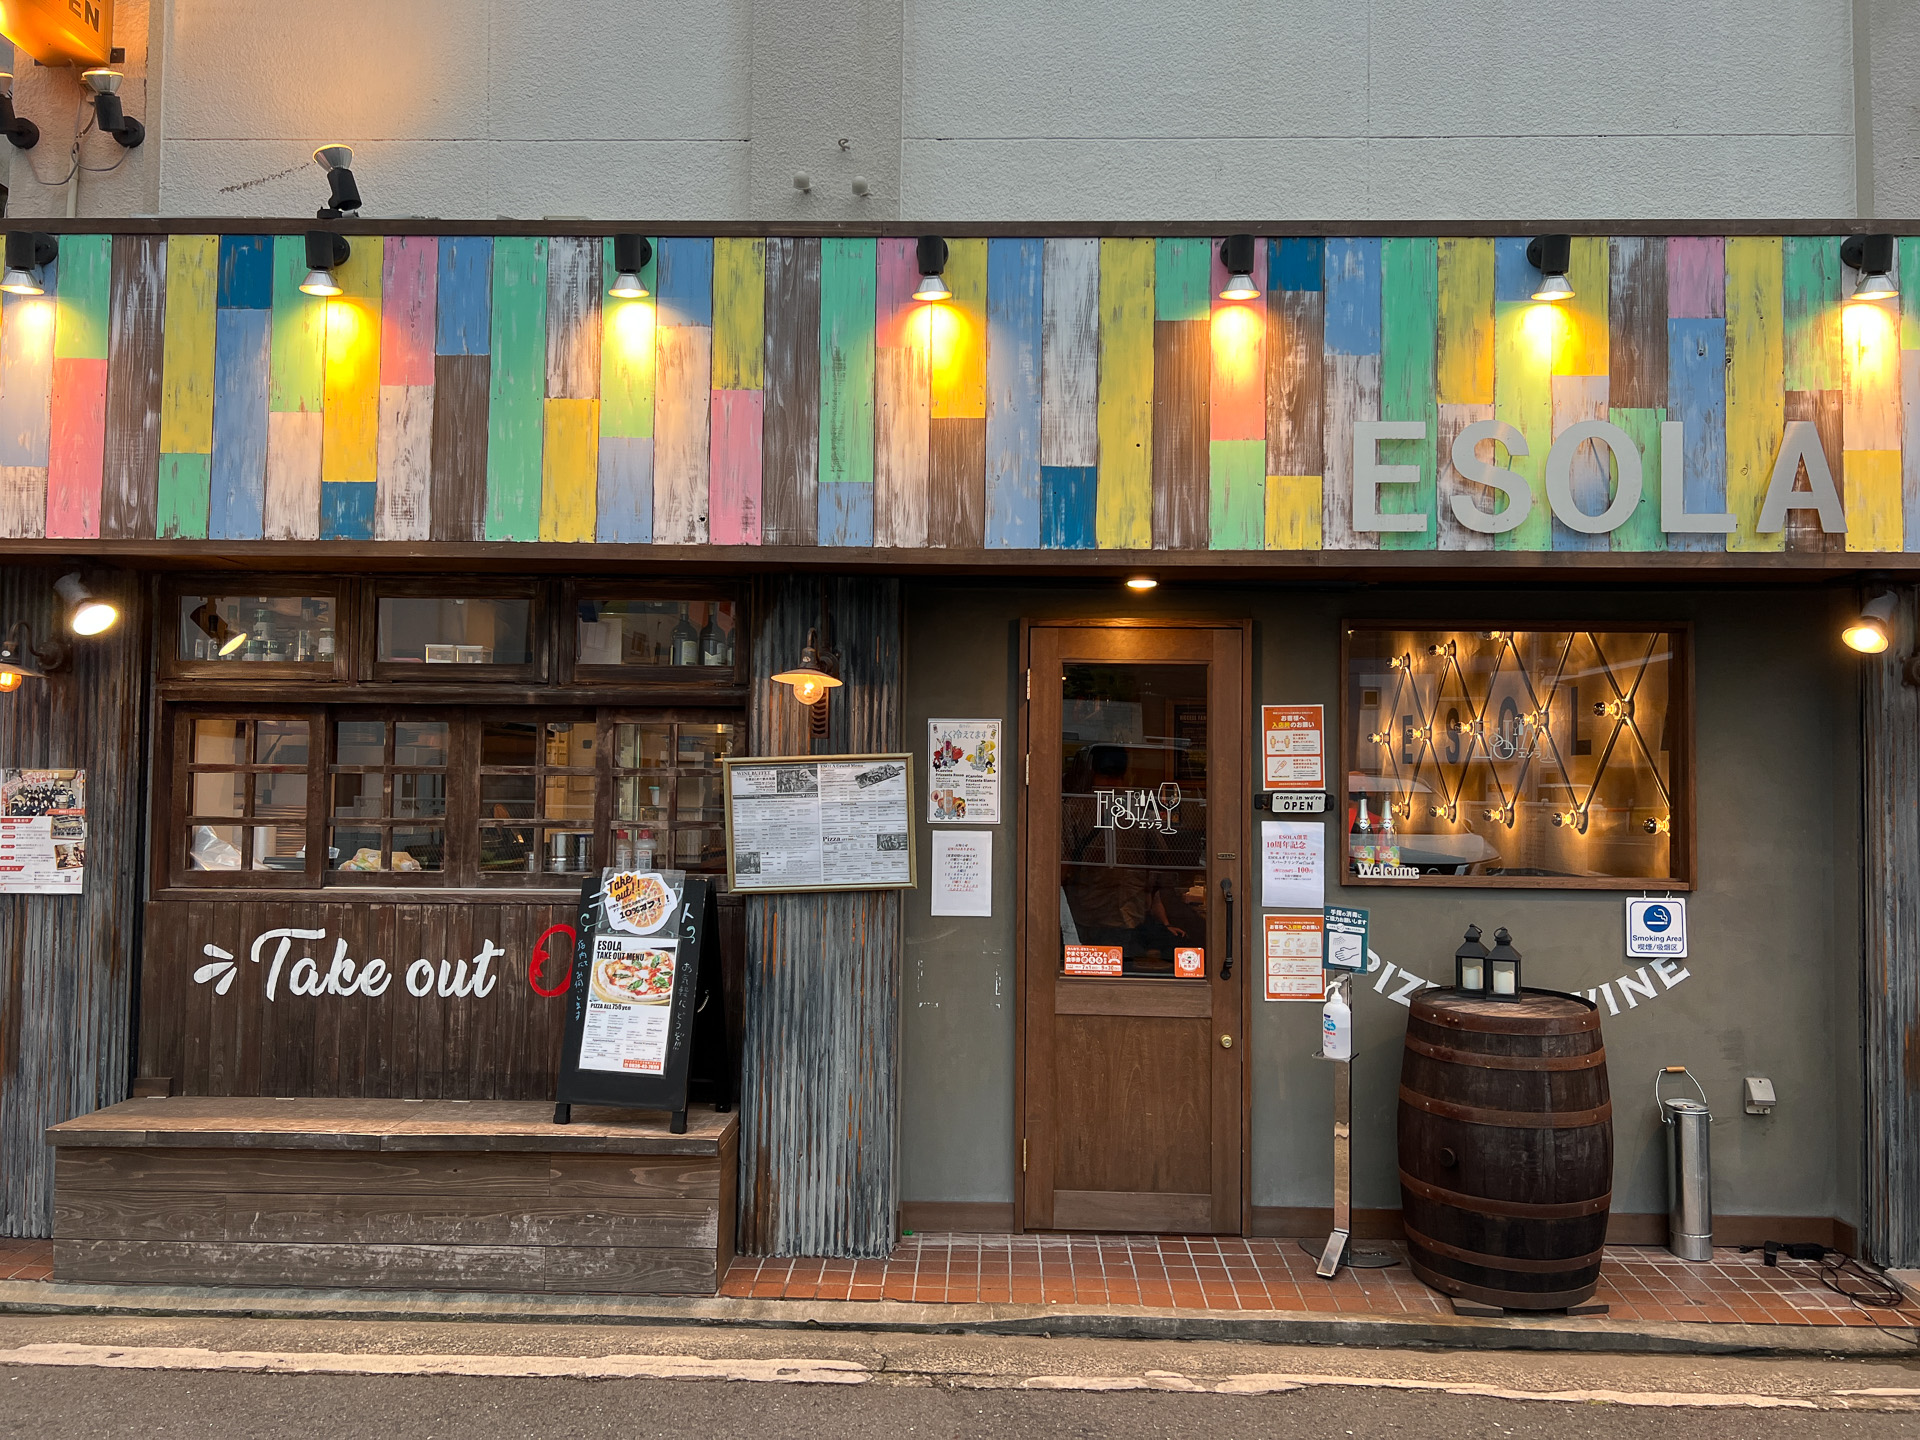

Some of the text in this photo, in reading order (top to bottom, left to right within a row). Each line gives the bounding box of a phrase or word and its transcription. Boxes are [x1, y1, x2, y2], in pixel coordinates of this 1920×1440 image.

[1352, 419, 1849, 534] ESOLA
[941, 729, 987, 741] よく冷えてます
[1284, 801, 1314, 811] OPEN
[1139, 821, 1163, 830] エソラ
[1267, 840, 1307, 849] 10周年記念
[1357, 862, 1420, 878] Welcome
[607, 875, 634, 894] Take
[615, 879, 641, 902] out!!
[1632, 934, 1682, 943] Smoking Area
[597, 940, 622, 951] ESOLA
[597, 951, 645, 962] TAKE OUT MENU
[250, 928, 392, 1002] Take
[405, 938, 506, 998] out
